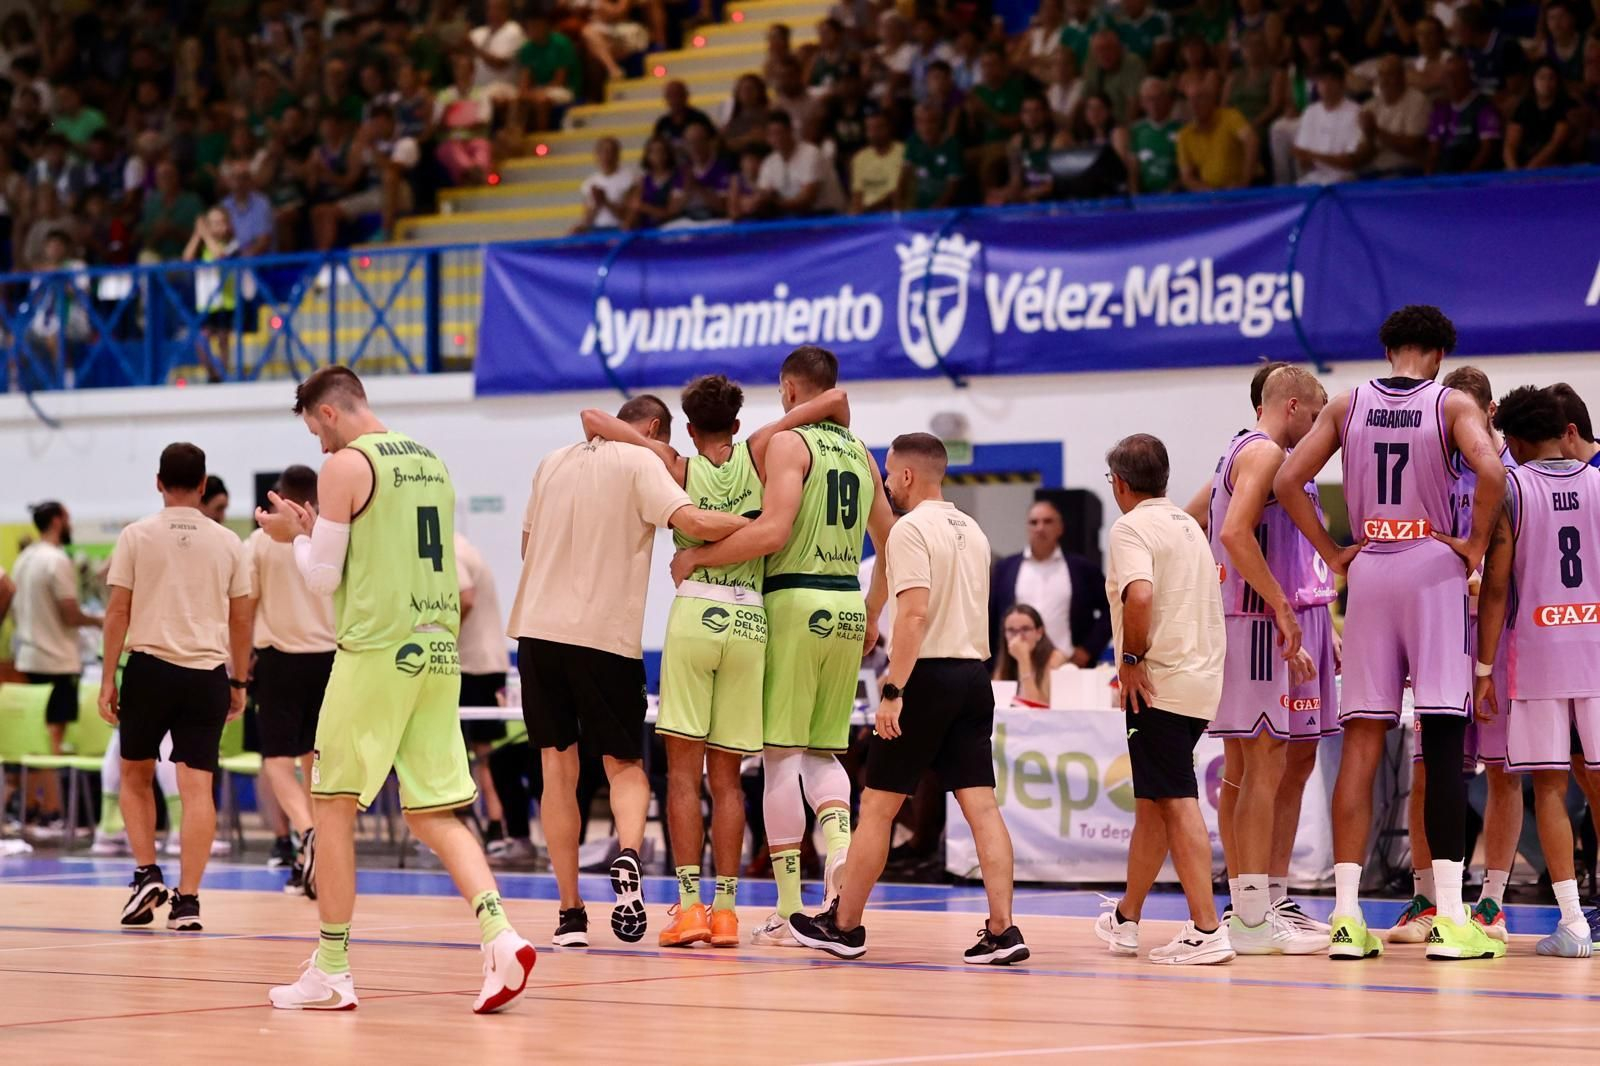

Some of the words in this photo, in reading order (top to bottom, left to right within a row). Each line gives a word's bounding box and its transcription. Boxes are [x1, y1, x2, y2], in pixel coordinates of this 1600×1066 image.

[580, 282, 883, 369] Ayuntamiento
[985, 257, 1304, 338] Vélez-Málaga
[1366, 408, 1422, 428] AGBAKOKO
[1373, 442, 1409, 505] 17
[826, 468, 860, 530] 19
[1552, 491, 1580, 511] ELLIS
[416, 505, 443, 572] 4
[1557, 526, 1583, 588] 8
[1541, 604, 1599, 626] GAZ
[732, 627, 767, 644] MÁLAG
[734, 619, 754, 631] DEL
[755, 624, 767, 636] SO
[837, 622, 853, 631] DEL
[430, 654, 449, 664] DEL
[1293, 698, 1320, 711] GAZ
[1080, 824, 1096, 838] Tu
